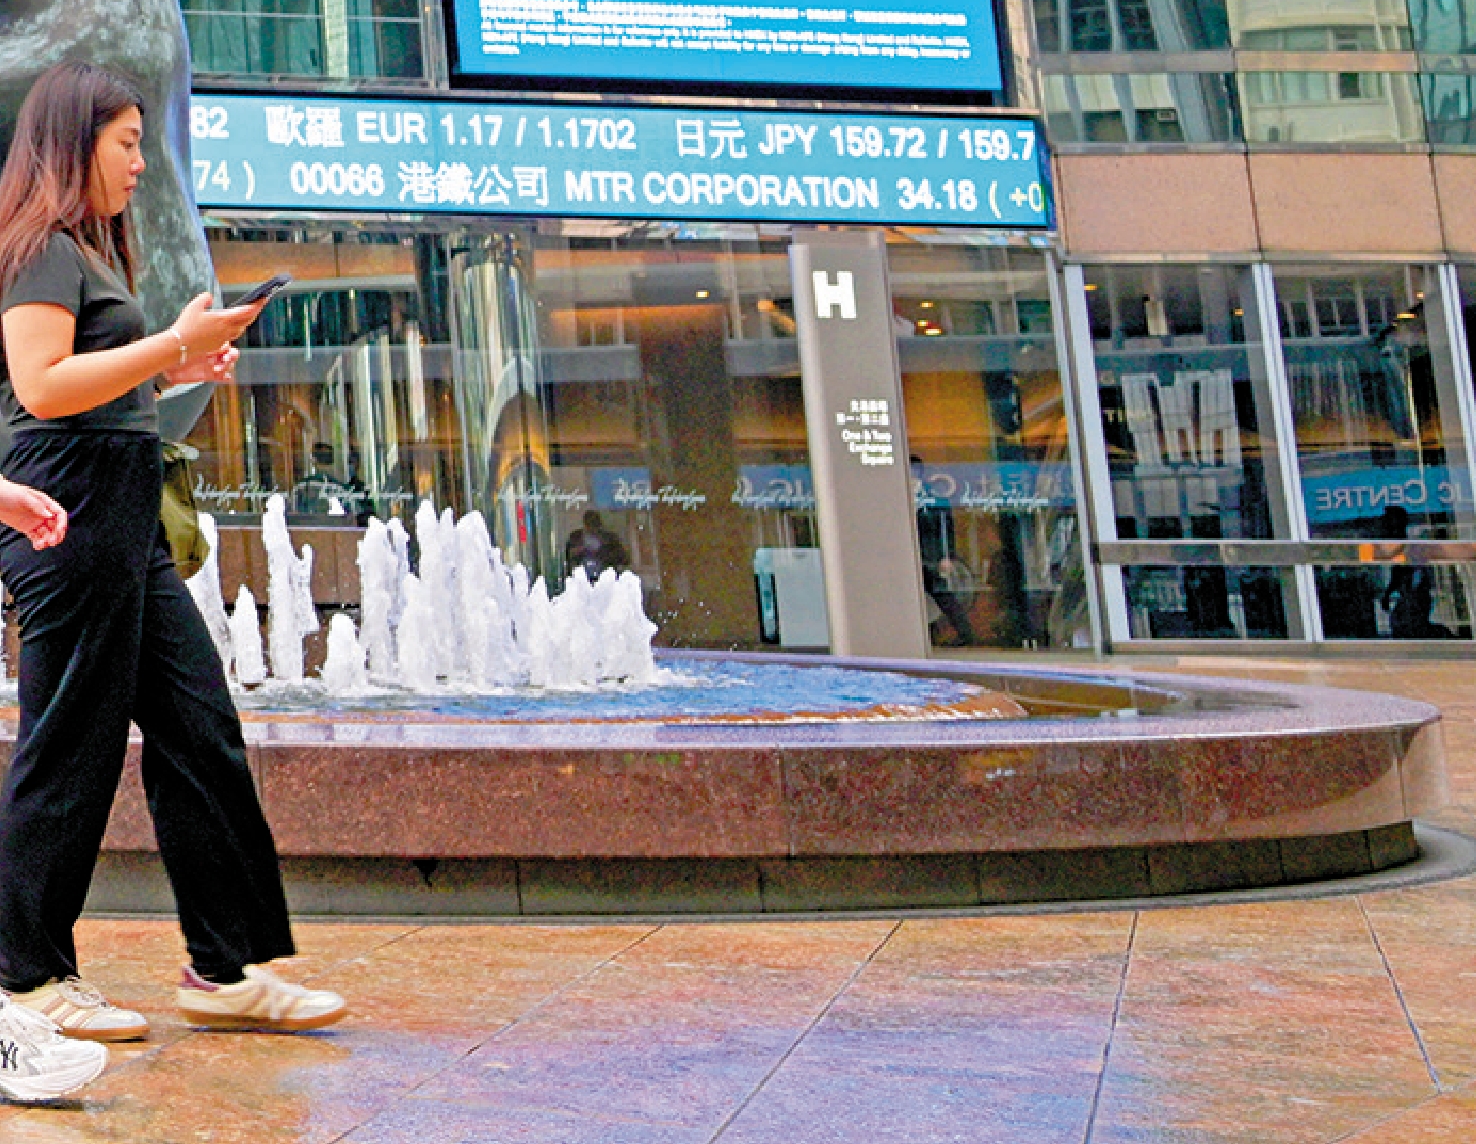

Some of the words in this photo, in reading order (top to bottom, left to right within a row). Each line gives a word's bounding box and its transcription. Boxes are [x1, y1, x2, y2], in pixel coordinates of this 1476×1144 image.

[357, 113, 425, 143] EUR
[442, 115, 502, 145] 1.17
[538, 118, 636, 149] 1.1702
[677, 120, 746, 158] 日元
[760, 125, 815, 154] JPY
[830, 126, 926, 156] 159.72
[960, 130, 1033, 160] 159.7
[291, 162, 383, 196] 00066
[398, 162, 547, 205] 港鐵公司
[566, 171, 634, 201] MTR
[644, 173, 878, 207] CORPORATION
[899, 179, 976, 209] 34.18
[813, 271, 856, 318] H
